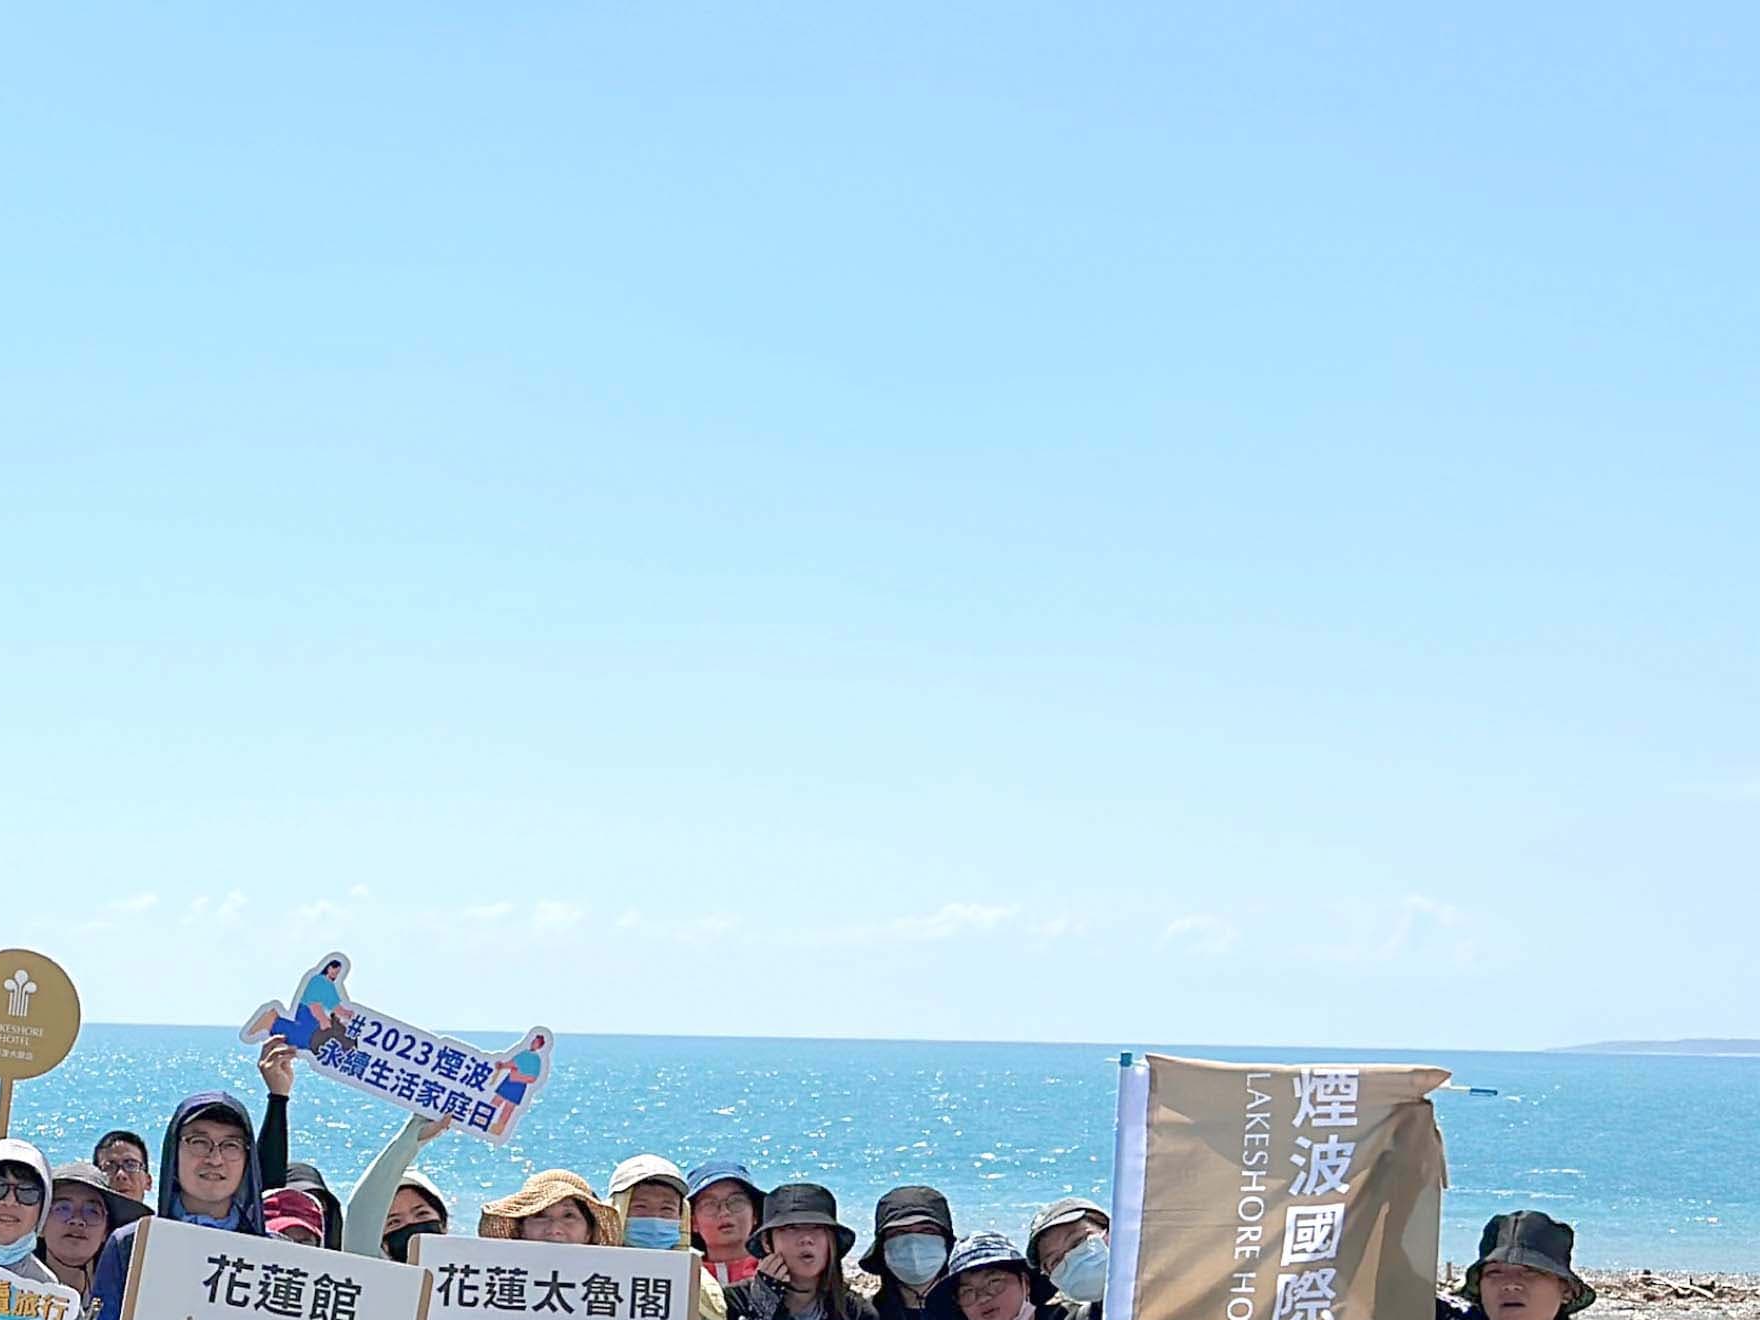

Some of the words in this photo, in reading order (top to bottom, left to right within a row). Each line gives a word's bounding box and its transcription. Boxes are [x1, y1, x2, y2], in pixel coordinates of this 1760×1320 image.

[316, 1039, 497, 1132] 永續生活家庭日
[1234, 1072, 1272, 1260] LAKESHORE
[437, 1264, 672, 1320] 花蓮太魯閣
